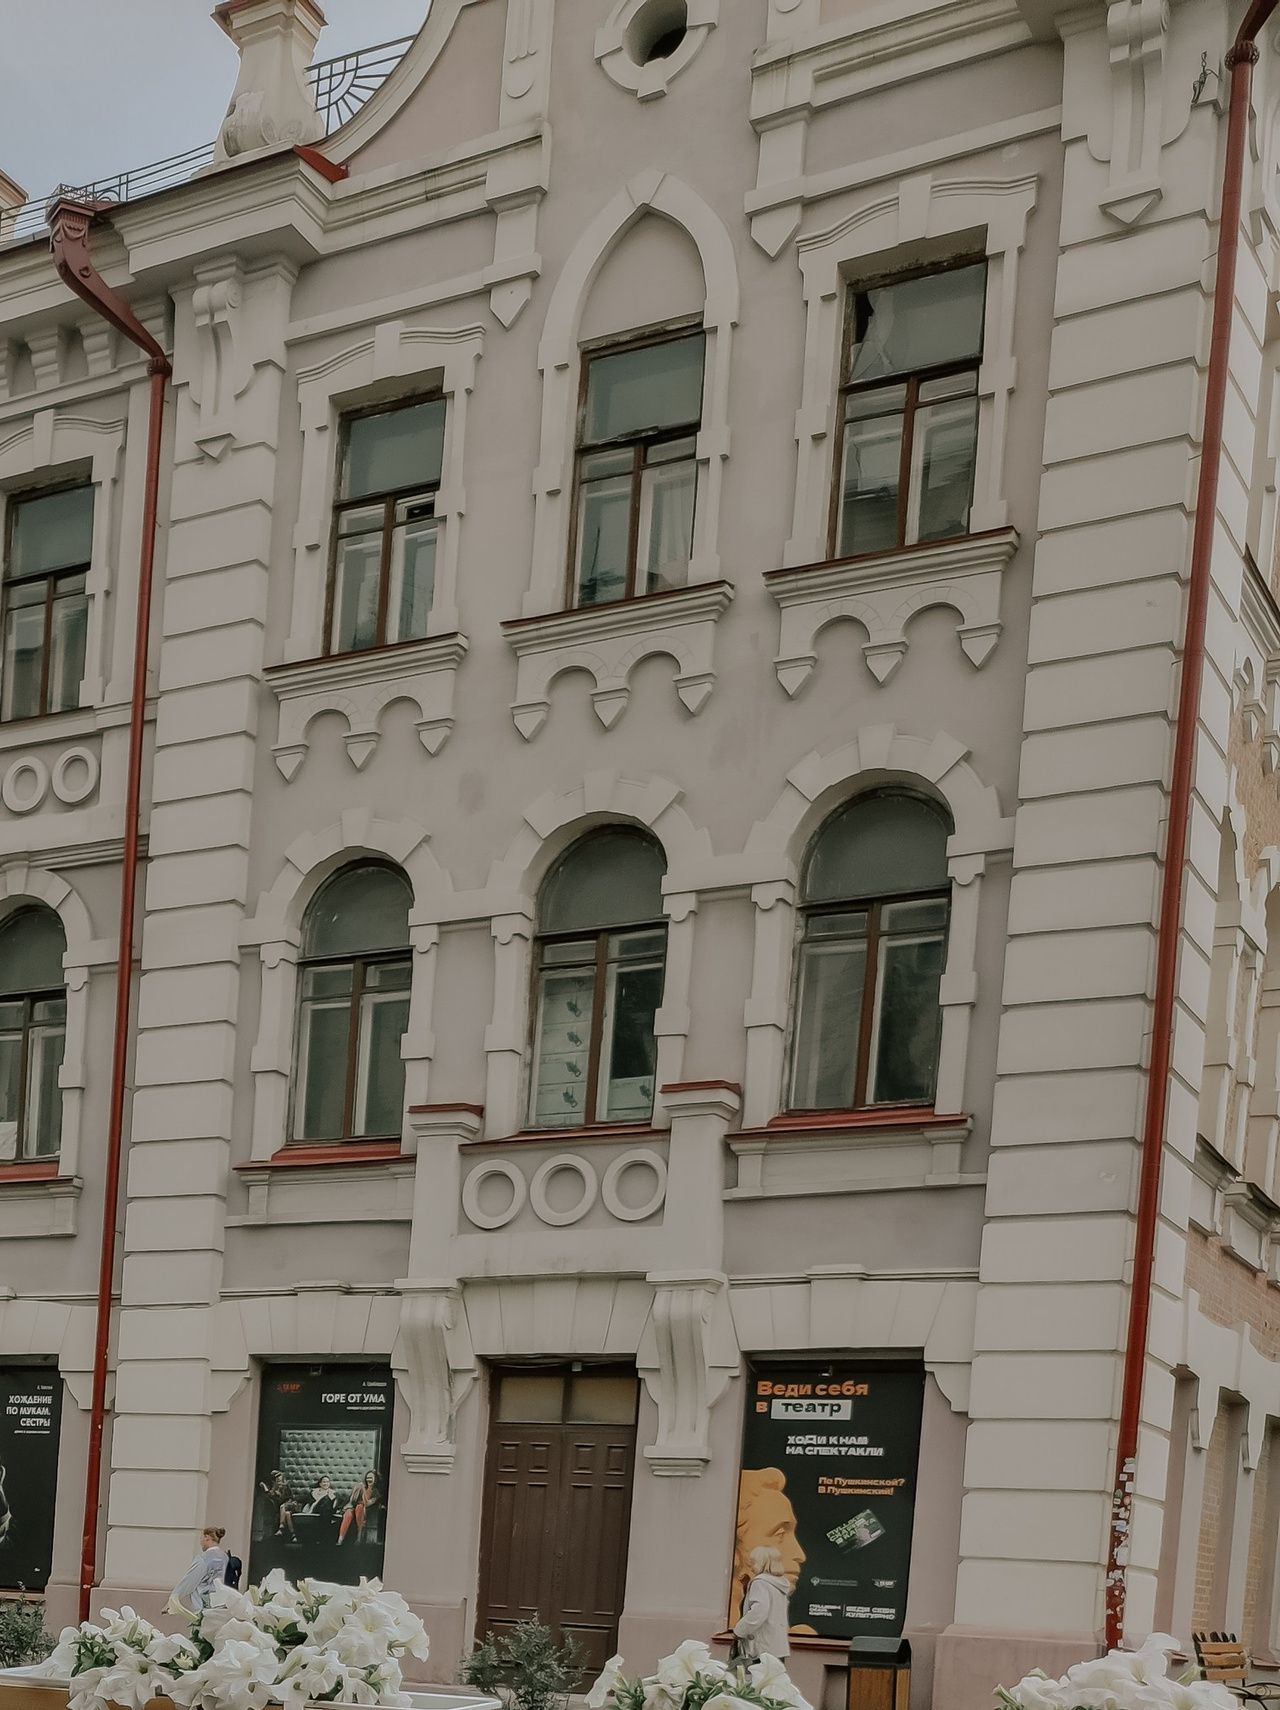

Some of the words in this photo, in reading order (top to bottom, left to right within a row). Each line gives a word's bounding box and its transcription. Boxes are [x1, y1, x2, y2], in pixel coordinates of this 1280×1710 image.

[757, 1381, 812, 1397] Веди
[815, 1380, 869, 1396] себя
[8, 1395, 52, 1404] ХОЖДЕНИЕ
[322, 1394, 346, 1403] ГОРЕ
[348, 1394, 362, 1403] ОТ
[363, 1394, 386, 1403] УМА
[6, 1406, 18, 1414] ПО
[20, 1407, 51, 1416] МУКАМ.
[756, 1402, 768, 1413] в
[781, 1402, 842, 1416] театр
[20, 1418, 50, 1426] СЕСТРЫ
[787, 1435, 826, 1445] ХОДИ
[829, 1436, 838, 1444] К
[840, 1436, 868, 1444] НАМ
[786, 1446, 804, 1455] НА
[805, 1447, 884, 1456] СПЕКТАКЛИ
[818, 1476, 832, 1484] По
[834, 1478, 905, 1486] Пушкинской?
[818, 1486, 826, 1494] В
[827, 1486, 894, 1496] Пушкинский!
